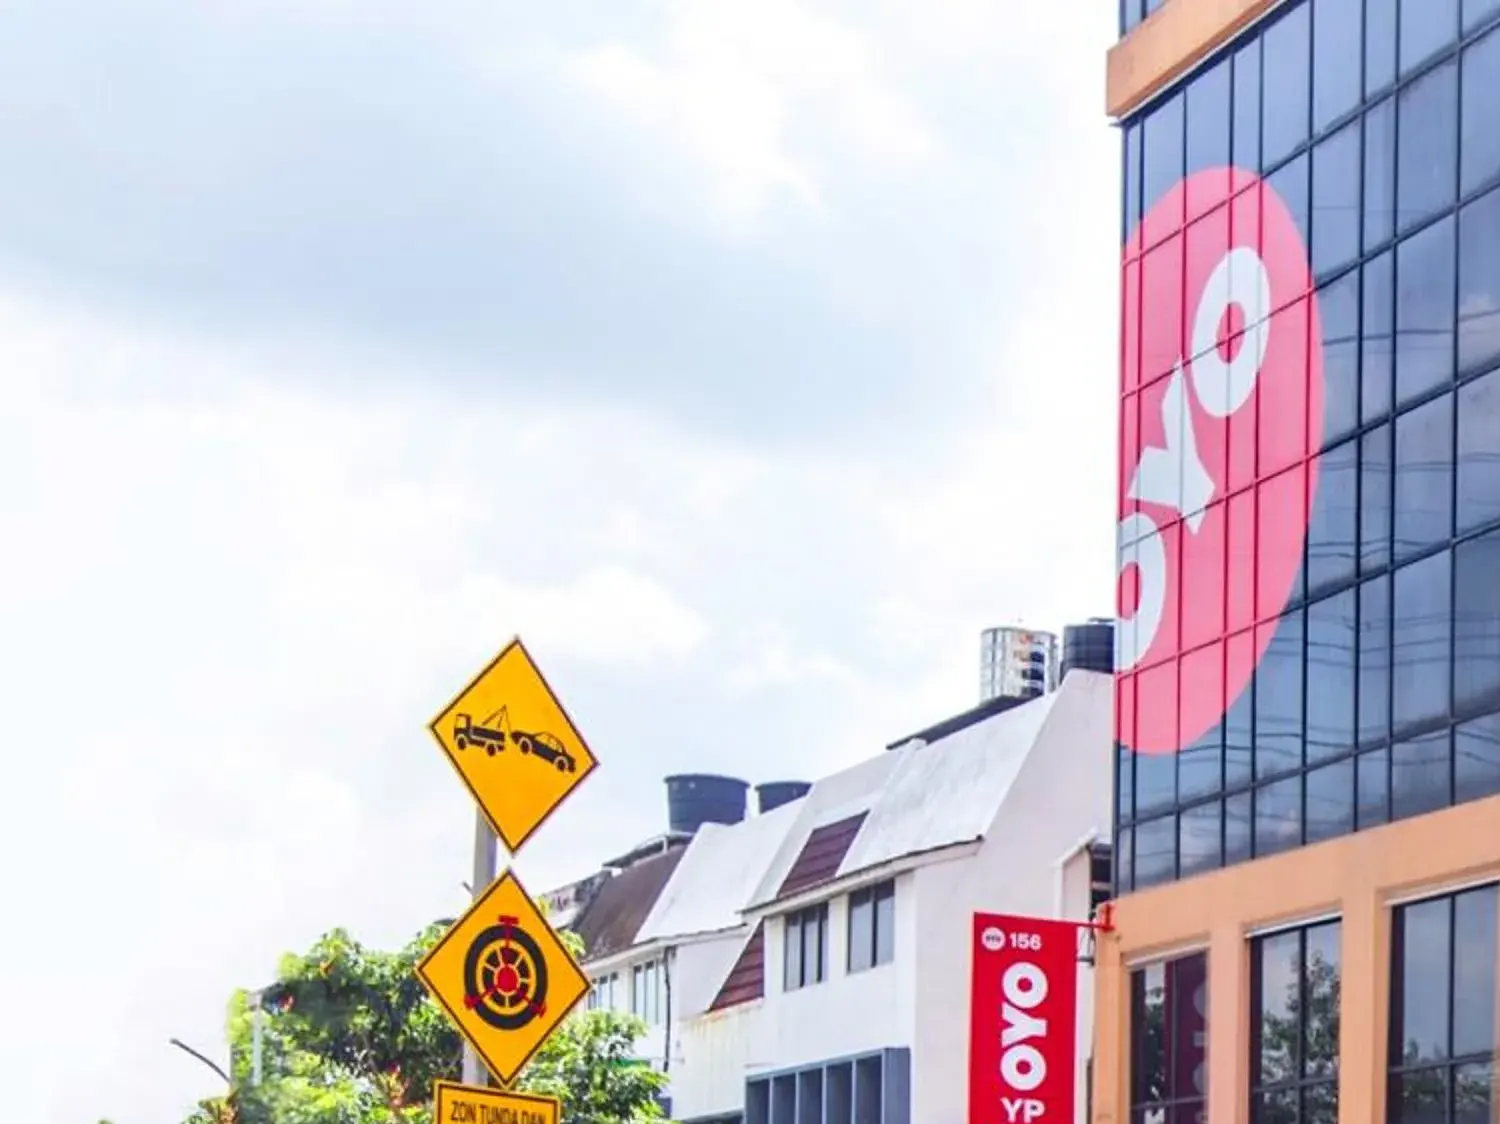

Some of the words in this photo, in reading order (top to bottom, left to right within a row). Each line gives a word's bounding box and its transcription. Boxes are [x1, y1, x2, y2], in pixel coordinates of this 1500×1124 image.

[1000, 961, 1049, 1092] OYO
[450, 1100, 477, 1124] ZON
[1001, 1097, 1046, 1124] YP
